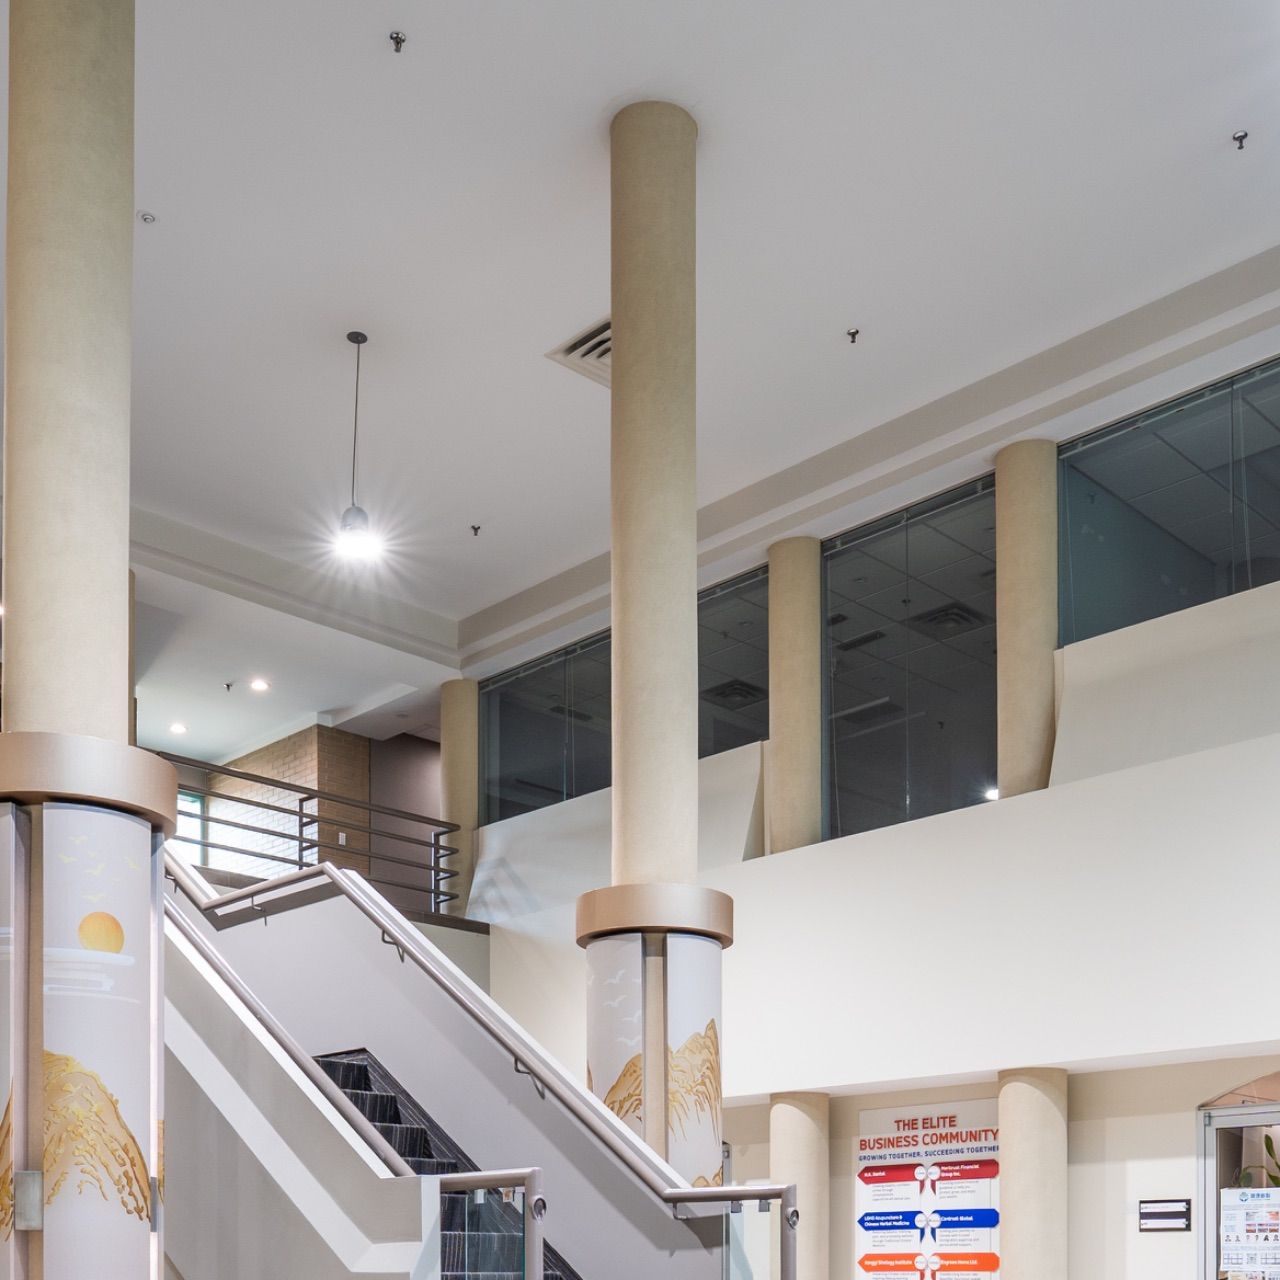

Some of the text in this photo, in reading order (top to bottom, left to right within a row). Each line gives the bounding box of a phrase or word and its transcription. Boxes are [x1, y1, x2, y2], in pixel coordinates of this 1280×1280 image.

[894, 1115, 957, 1132] THE ELITE
[859, 1128, 999, 1151] BUSINESS COMMUNITY
[859, 1153, 887, 1161] GROWING
[924, 1148, 964, 1157] SUCCEEDING
